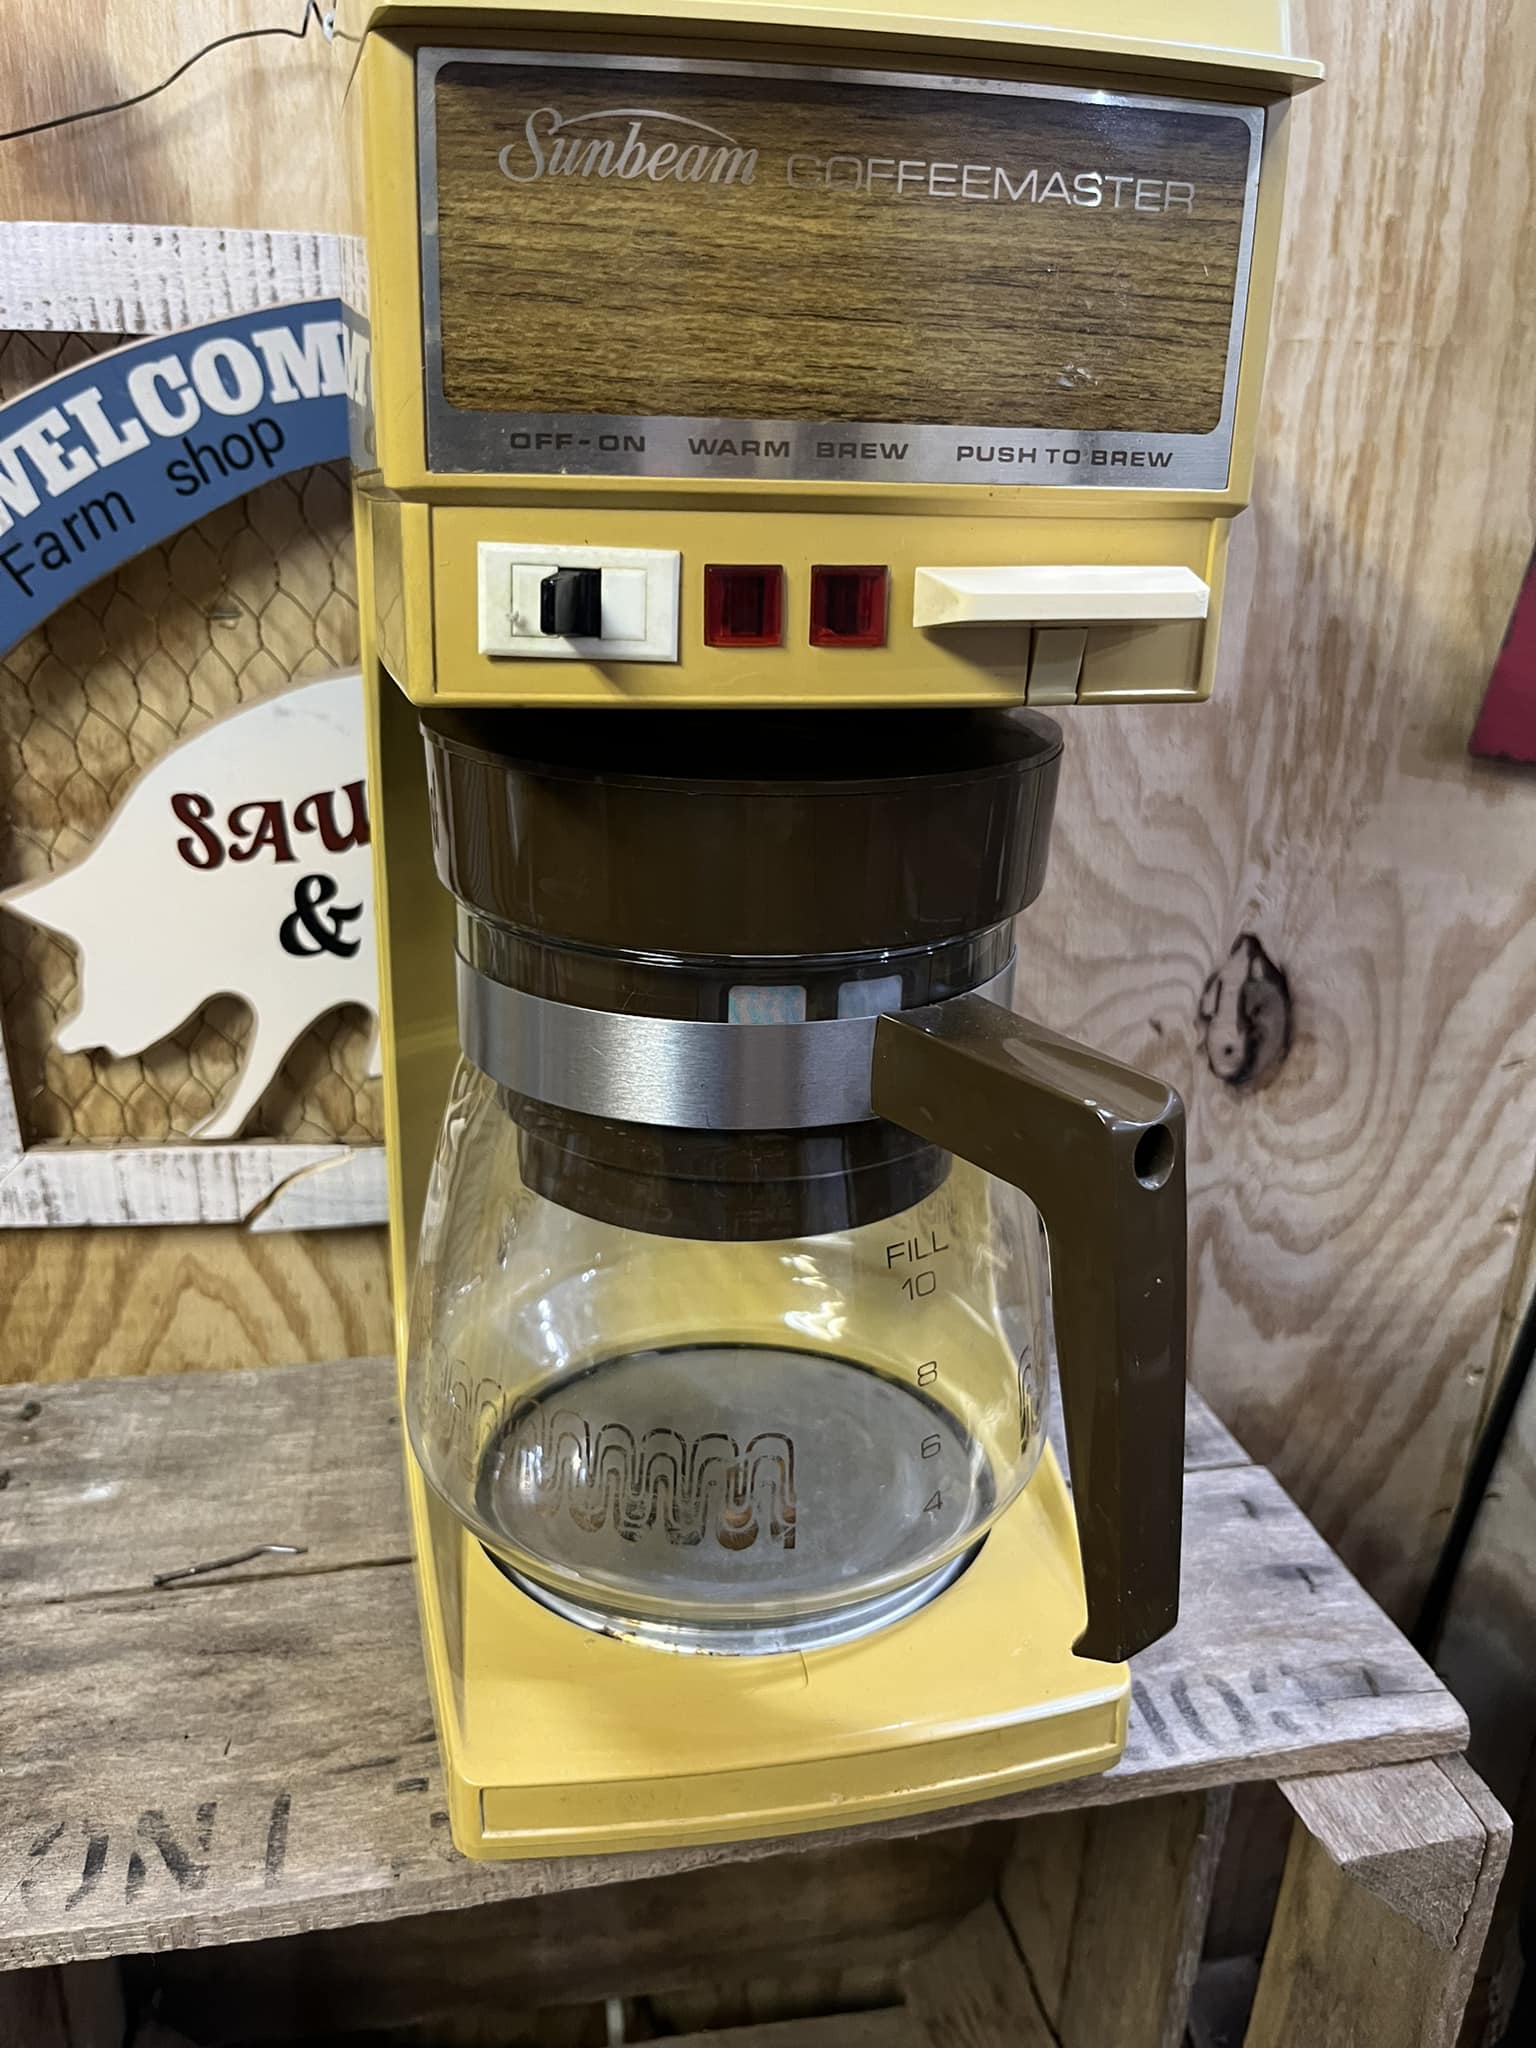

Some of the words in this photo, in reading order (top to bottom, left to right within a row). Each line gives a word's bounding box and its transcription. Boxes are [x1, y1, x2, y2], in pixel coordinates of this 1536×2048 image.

[498, 107, 760, 186] Sunbeam
[786, 153, 1197, 215] COFFEEMASTER
[687, 437, 791, 459] WARM
[815, 441, 909, 460] BREW
[956, 445, 1036, 464] PUSH
[1045, 448, 1081, 465] TO
[1090, 449, 1174, 468] BREW
[0, 491, 136, 598] Farm
[165, 417, 287, 498] shop
[279, 874, 363, 958] &
[886, 1231, 950, 1270] FILL
[901, 1270, 936, 1301] 10
[917, 1360, 938, 1387] 8
[920, 1433, 942, 1460] 6
[922, 1489, 943, 1513] 4
